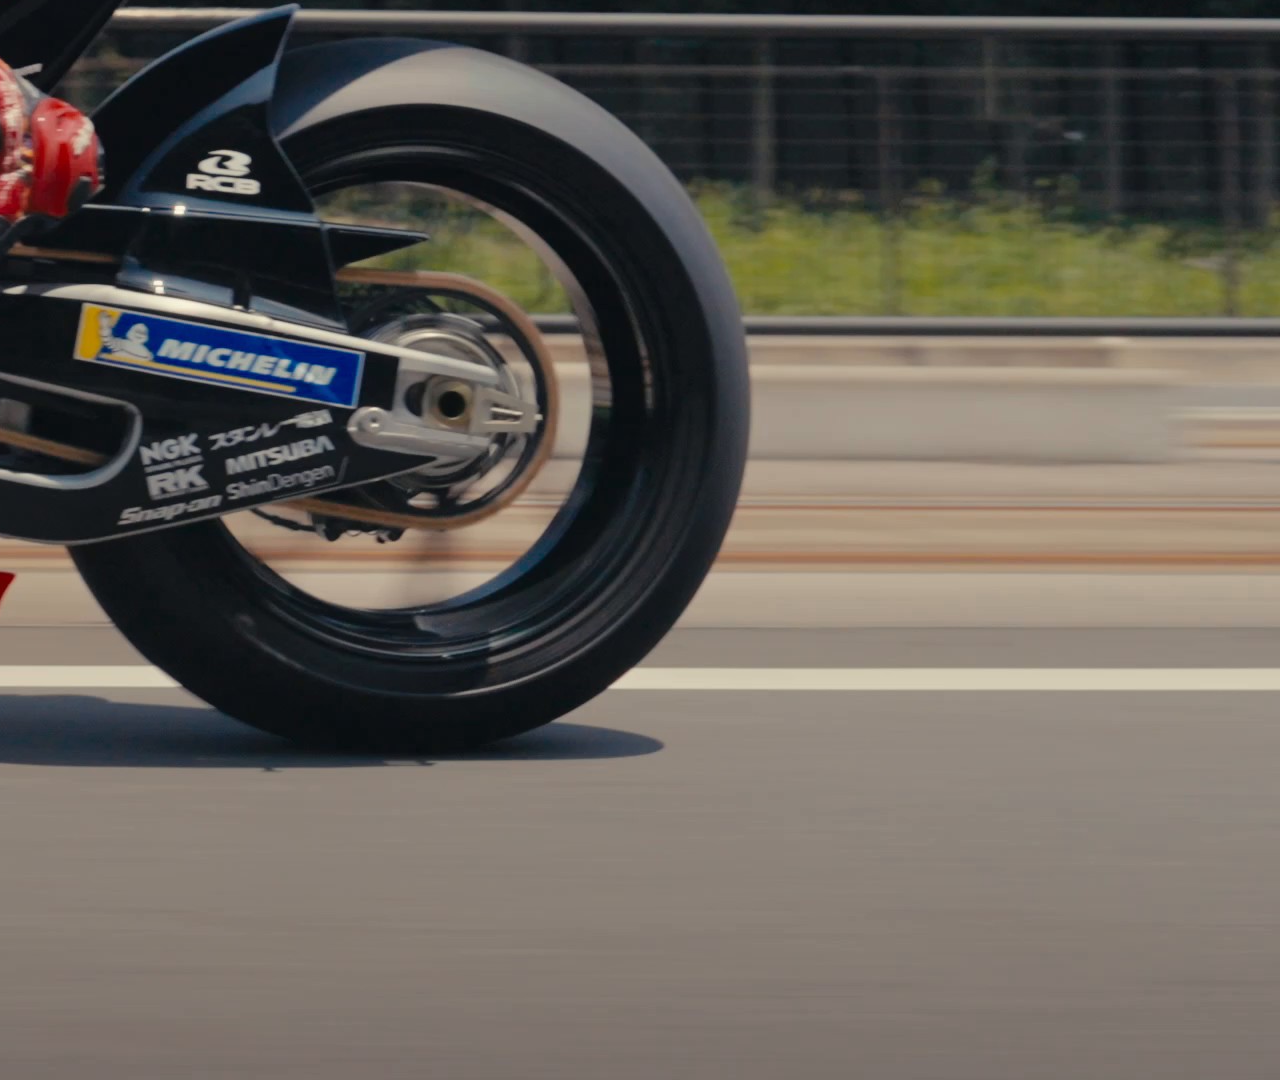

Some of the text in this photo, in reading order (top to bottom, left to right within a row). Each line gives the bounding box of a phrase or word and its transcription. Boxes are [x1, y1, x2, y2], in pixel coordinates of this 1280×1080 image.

[185, 172, 261, 195] RCB
[156, 338, 338, 386] MICHELIN
[140, 432, 202, 466] NGK
[224, 435, 335, 476] MITSUBA
[145, 464, 209, 500] RK
[226, 465, 335, 500] ShinDengen
